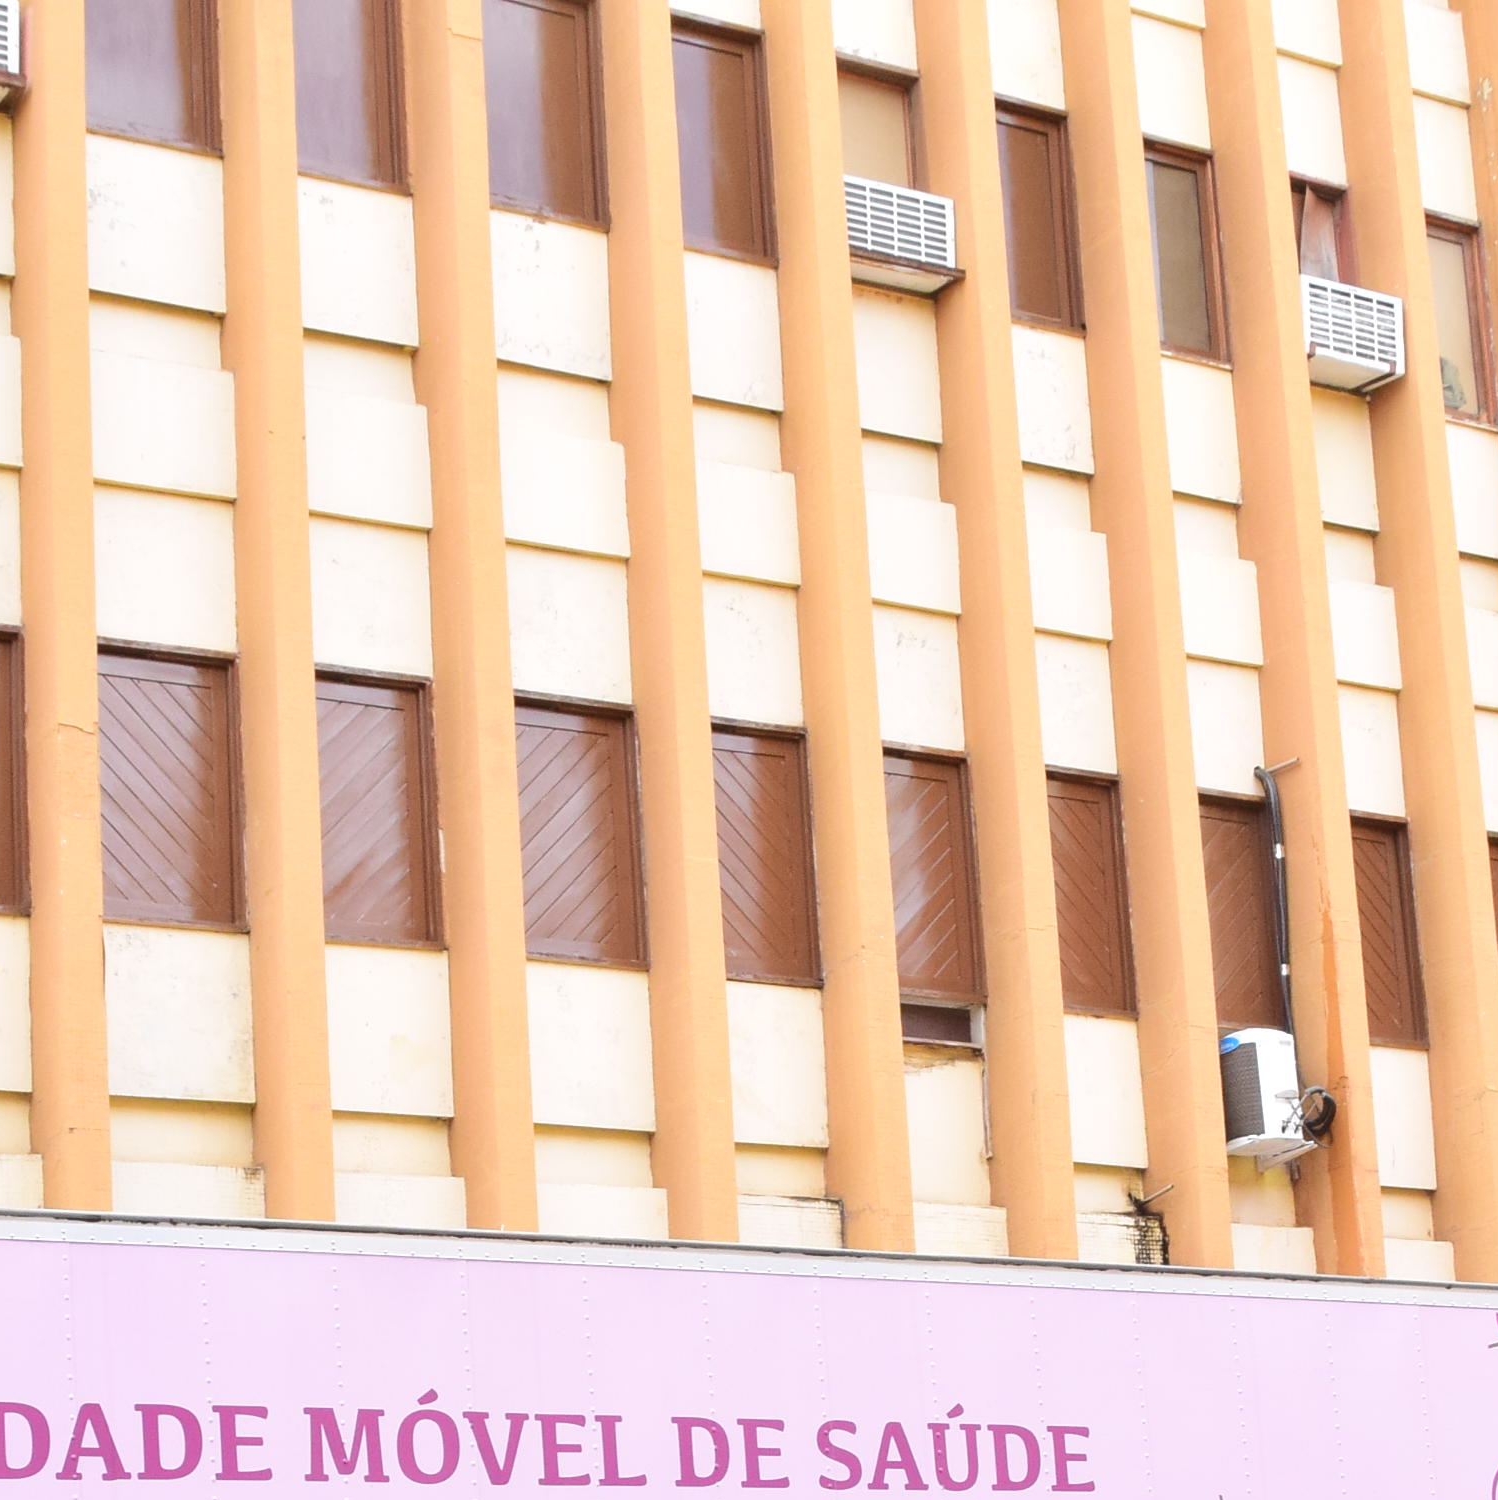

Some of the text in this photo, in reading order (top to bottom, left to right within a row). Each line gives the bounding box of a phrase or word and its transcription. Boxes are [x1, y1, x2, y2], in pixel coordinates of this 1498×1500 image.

[304, 1389, 647, 1487] MÓVEL
[672, 1417, 790, 1489] DE
[817, 1404, 1096, 1492] SAÚDE
